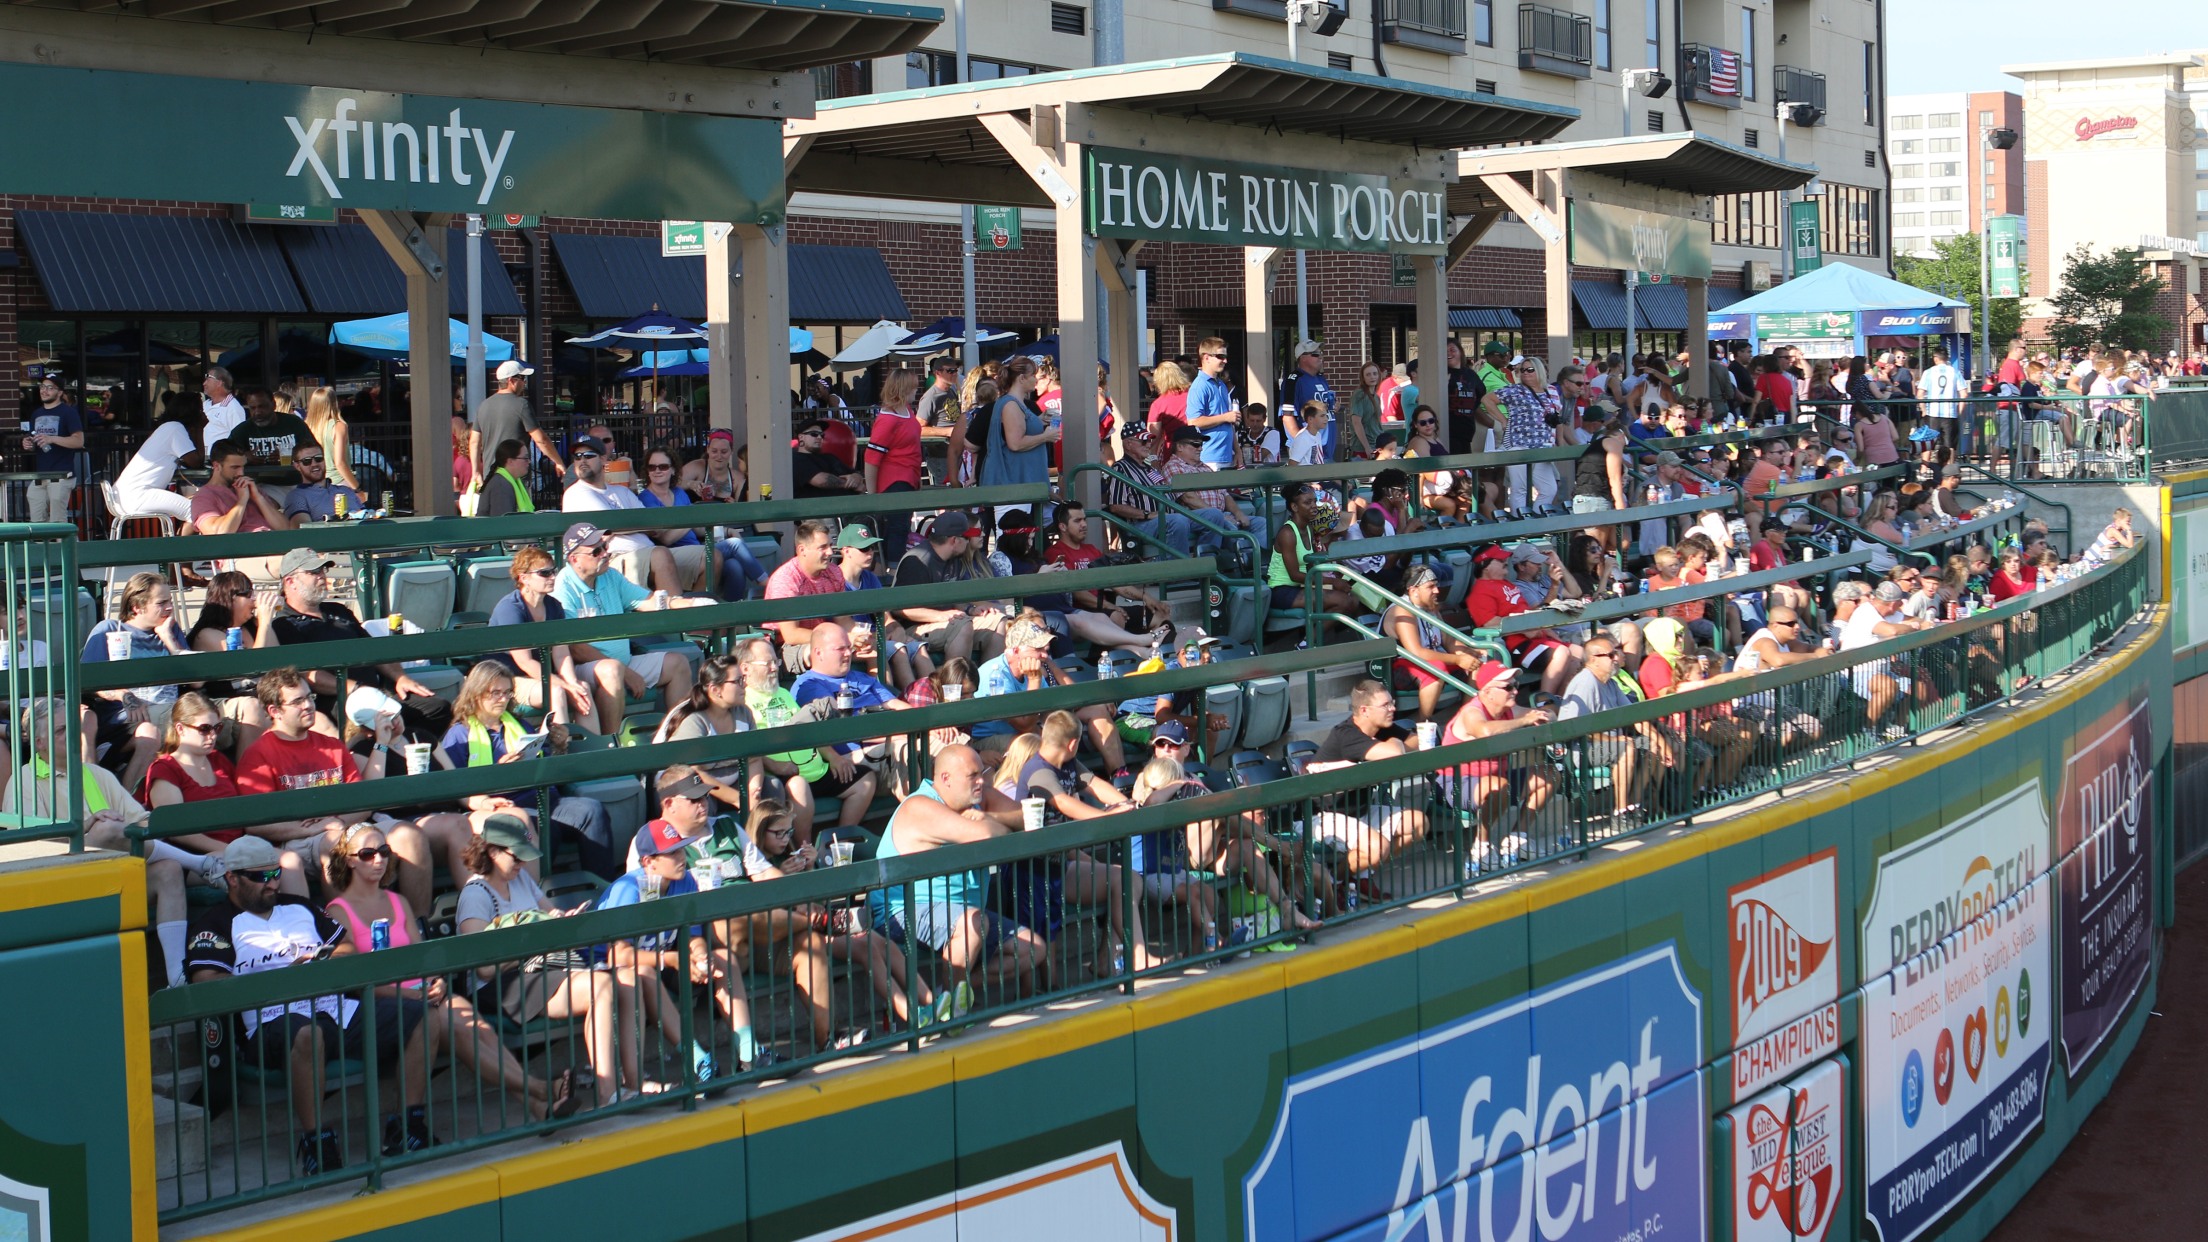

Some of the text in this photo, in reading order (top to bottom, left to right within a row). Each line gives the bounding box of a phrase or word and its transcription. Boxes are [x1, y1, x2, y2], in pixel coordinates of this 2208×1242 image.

[284, 98, 516, 205] xfinity
[1099, 163, 1445, 244] HOME RUN PORCH
[674, 233, 697, 245] xfinity
[1631, 215, 1668, 270] xfinity
[1707, 322, 1737, 330] IGHT
[1879, 316, 1953, 326] BUD LIGHT
[1938, 375, 1947, 394] 9
[249, 434, 296, 451] STETSON
[1736, 903, 1800, 1034] 2009
[2081, 923, 2100, 969] THE
[1891, 992, 1941, 1040] Documents.
[1945, 964, 1980, 1005] Networks.
[2081, 971, 2100, 1006] YOUR
[1738, 1004, 1835, 1088] CHAMPIONS
[1384, 1018, 1662, 1242] Afdent
[1756, 1117, 1772, 1136] the
[1888, 1069, 2038, 1219] PERRYproTECH.com 260-483-6064
[1644, 1213, 1664, 1238] P.C.
